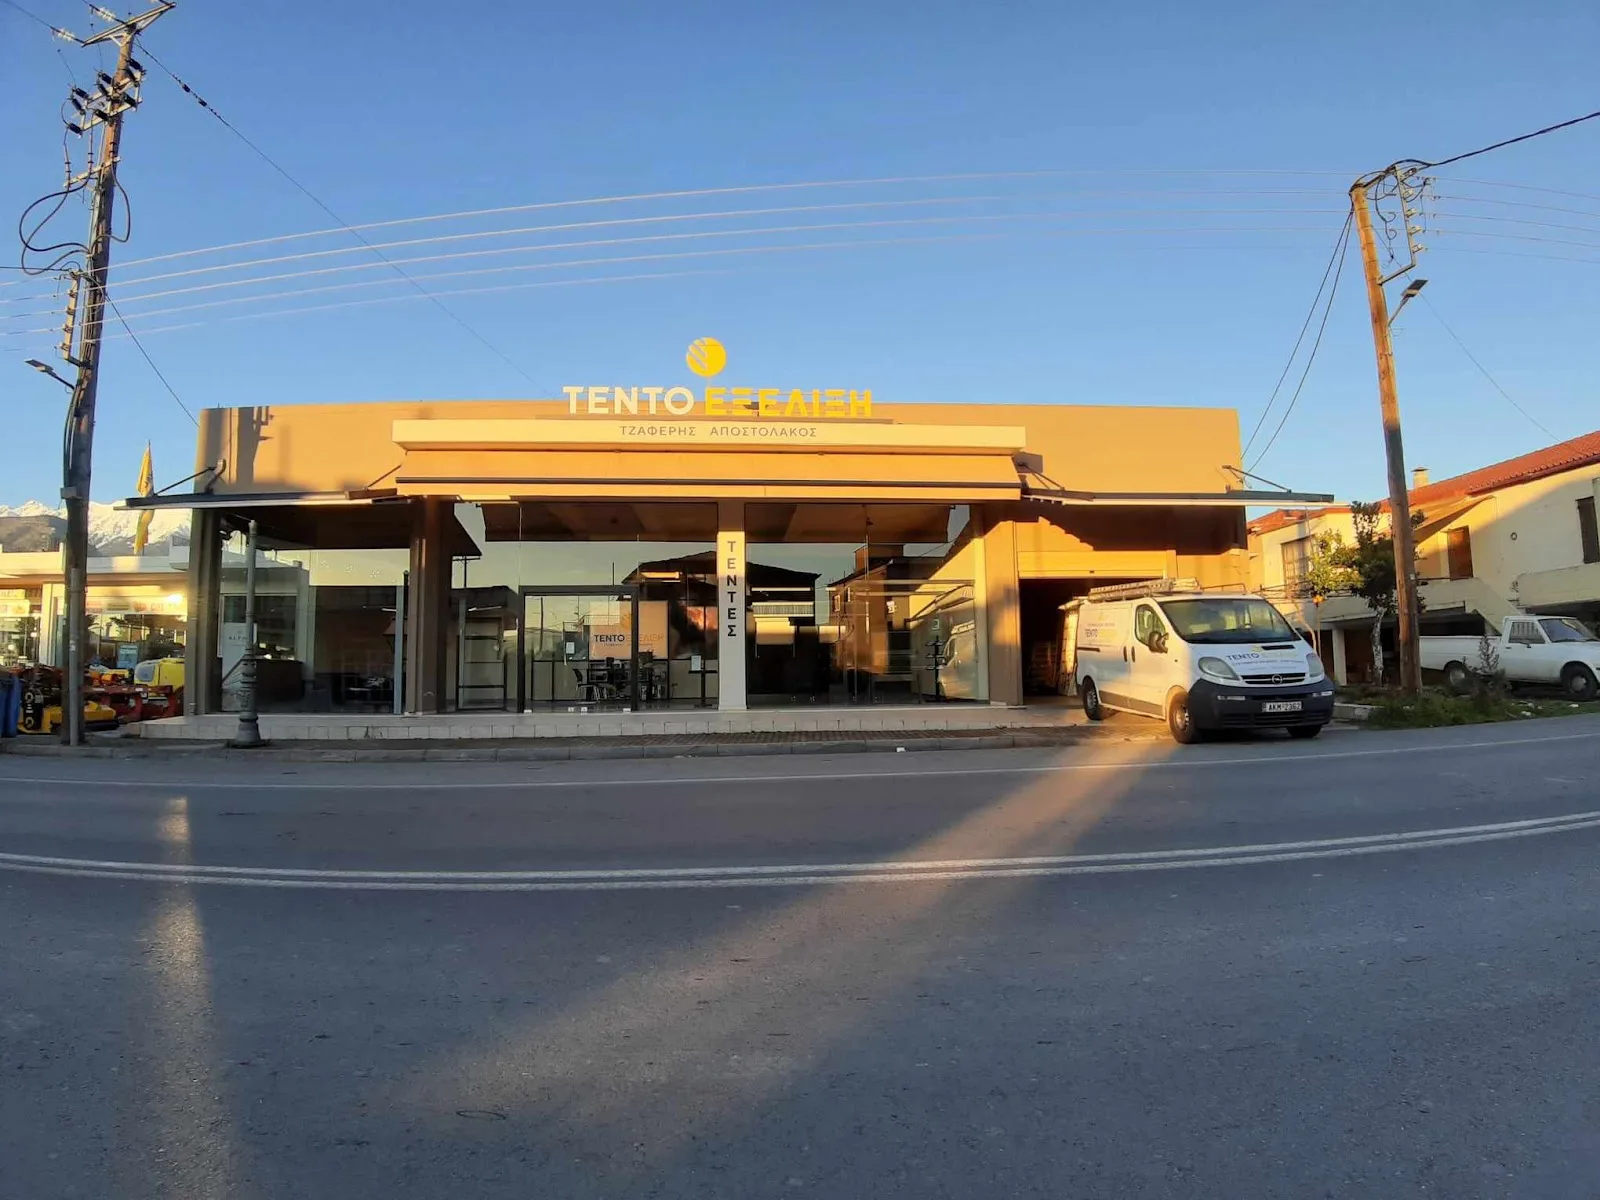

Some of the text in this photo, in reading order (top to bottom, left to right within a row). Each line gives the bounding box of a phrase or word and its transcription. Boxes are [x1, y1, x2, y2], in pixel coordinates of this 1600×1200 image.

[562, 386, 873, 418] ΤΕΝΤΟ ΕΞΕΛΙΞΗ
[620, 425, 818, 438] ΤΖΑΦΕΡΗΣ ΑΠΟΣΤΟΛΑΚΟΣ
[726, 540, 737, 637] ΤΕΝΤΕΣ
[593, 634, 625, 642] ΤΕΝΤΟ
